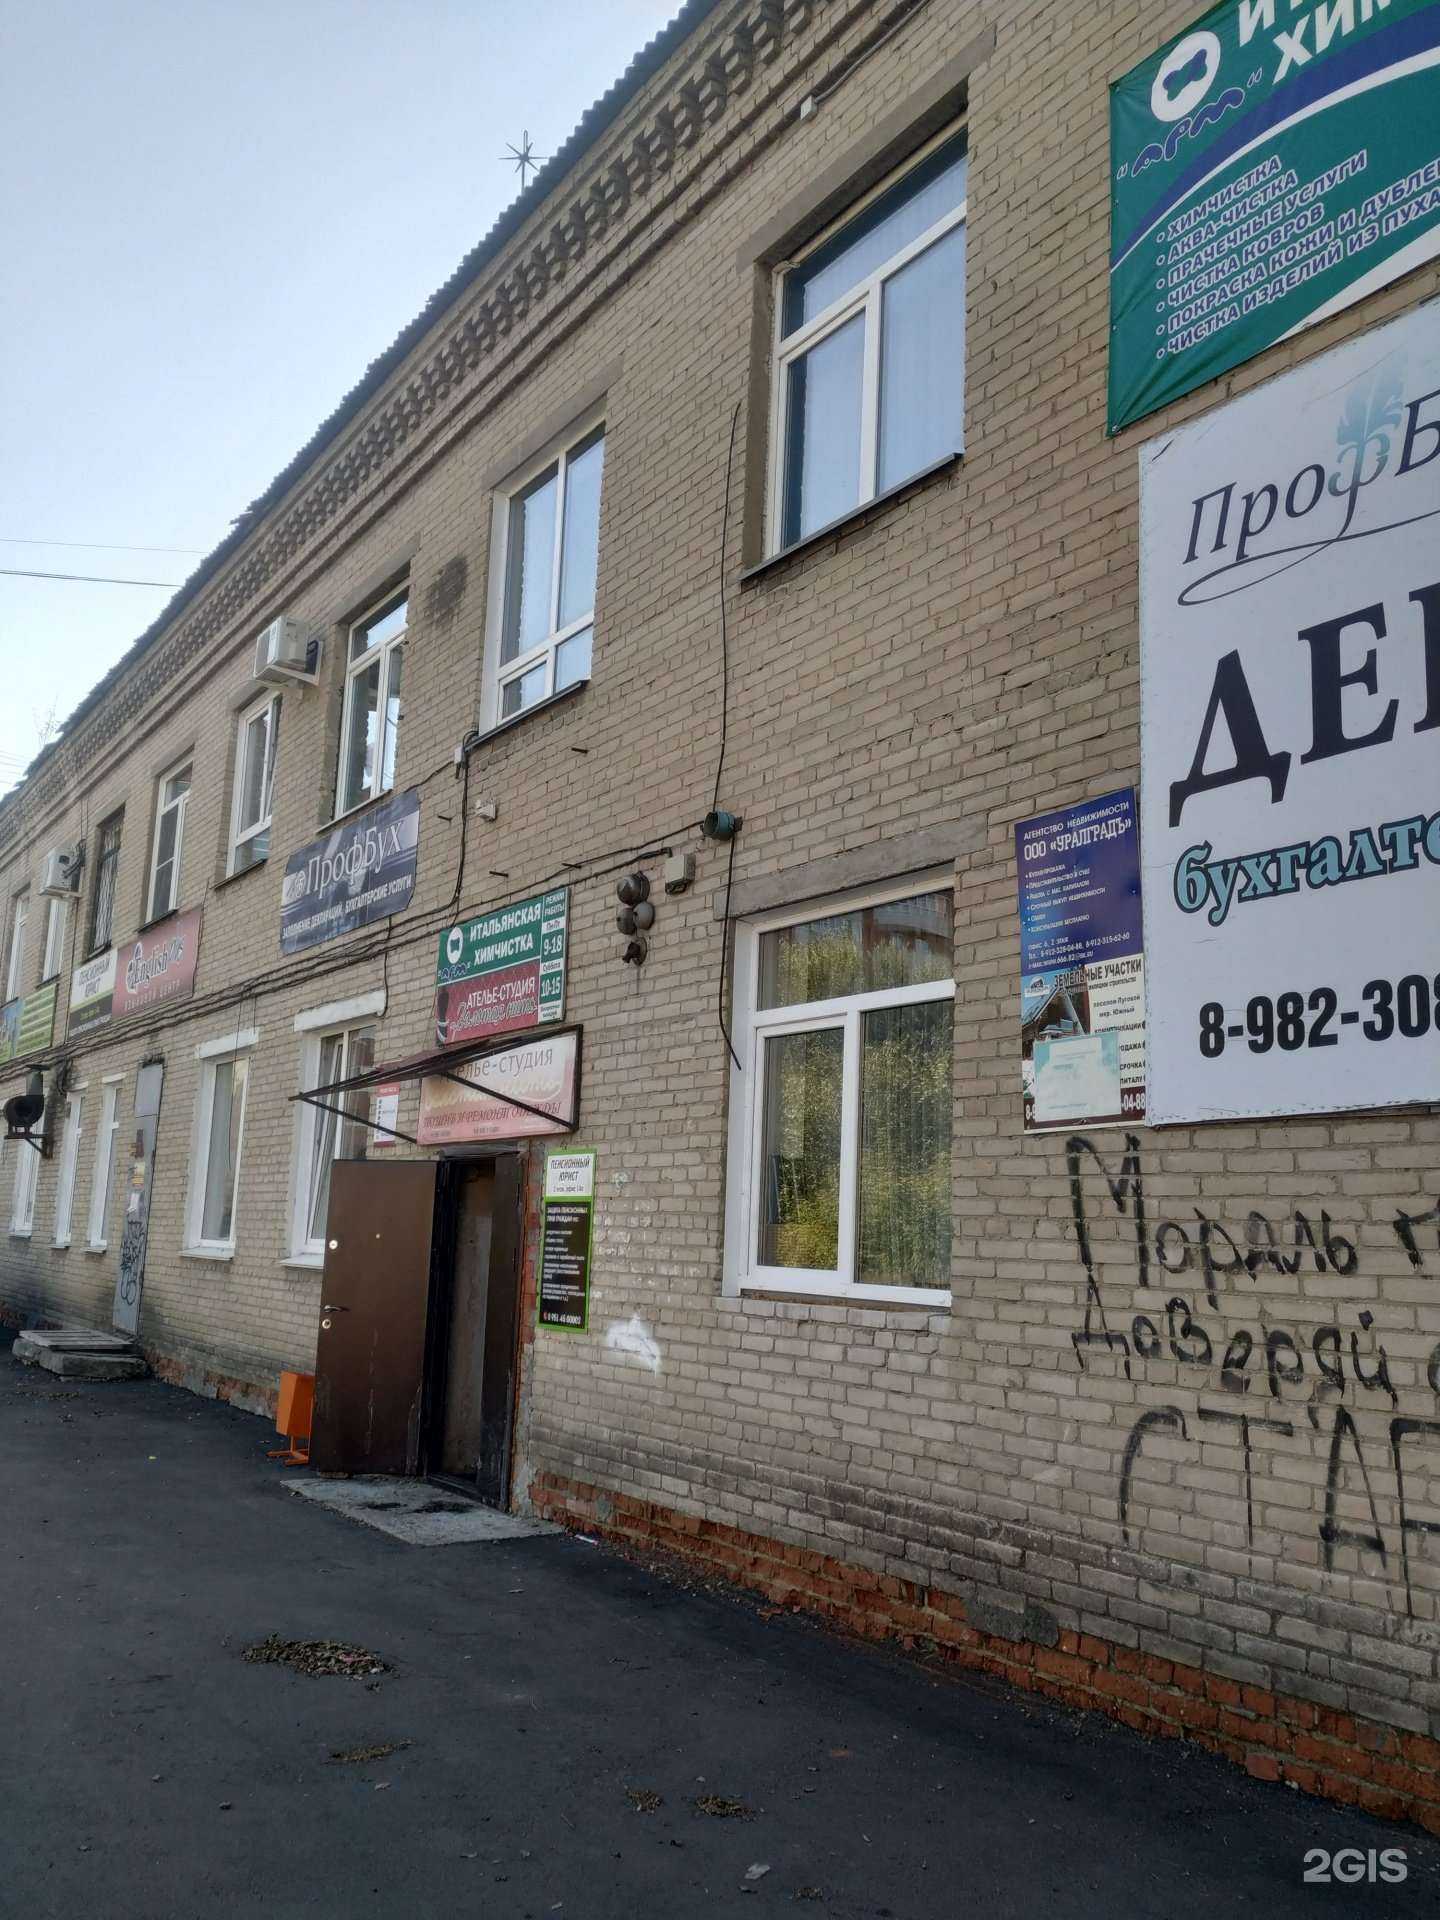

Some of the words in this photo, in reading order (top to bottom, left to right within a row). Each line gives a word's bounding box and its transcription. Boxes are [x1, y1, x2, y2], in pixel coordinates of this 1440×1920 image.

[1168, 154, 1282, 241] ХИМЧИСТКА
[1168, 169, 1299, 264] АКВА-ЧИСТКА
[1168, 201, 1283, 287] ПРАЧЕЧНЫЕ
[1285, 149, 1367, 215] УСЛУГИ
[1168, 262, 1267, 333] ПОКРАСКА
[1270, 221, 1334, 274] КОЖИ
[1338, 208, 1356, 234] И
[1359, 157, 1440, 226] ДУБЛЕ
[1168, 254, 1240, 306] ЧИСТКА
[1243, 203, 1324, 266] КОВРОВ
[1168, 302, 1240, 354] ЧИСТКА
[1243, 239, 1343, 314] ИЗДЕЛИЙ
[1347, 223, 1379, 256] ИЗ
[1168, 580, 1440, 829] ДЕ
[1024, 822, 1064, 841] АГЕНТСТВО
[1067, 800, 1130, 830] НЕДВИЖИМОСТИ
[1024, 840, 1047, 861] ООО
[306, 820, 403, 899] ПрофБух
[469, 902, 541, 943] ИТАЛЬЯНСКАЯ
[473, 932, 534, 966] ХИМЧИСТКА
[543, 934, 562, 956] 9-18
[466, 976, 536, 1010] АТЕЛЬЕ-СТУДИЯ
[541, 976, 561, 998] 10-15
[1053, 967, 1103, 988] ЗЕМЕЛЬНЫЕ
[1104, 957, 1143, 981] УЧАСТКИ
[1199, 973, 1440, 1058] 8-982-30
[1119, 1041, 1142, 1053] ОДАЖА
[550, 1155, 591, 1169] ПЕНСИОННЫЙ
[559, 1170, 580, 1182] ЮРИСТ
[1066, 1132, 1358, 1312] Мораль
[1071, 1273, 1398, 1429] Доверяй
